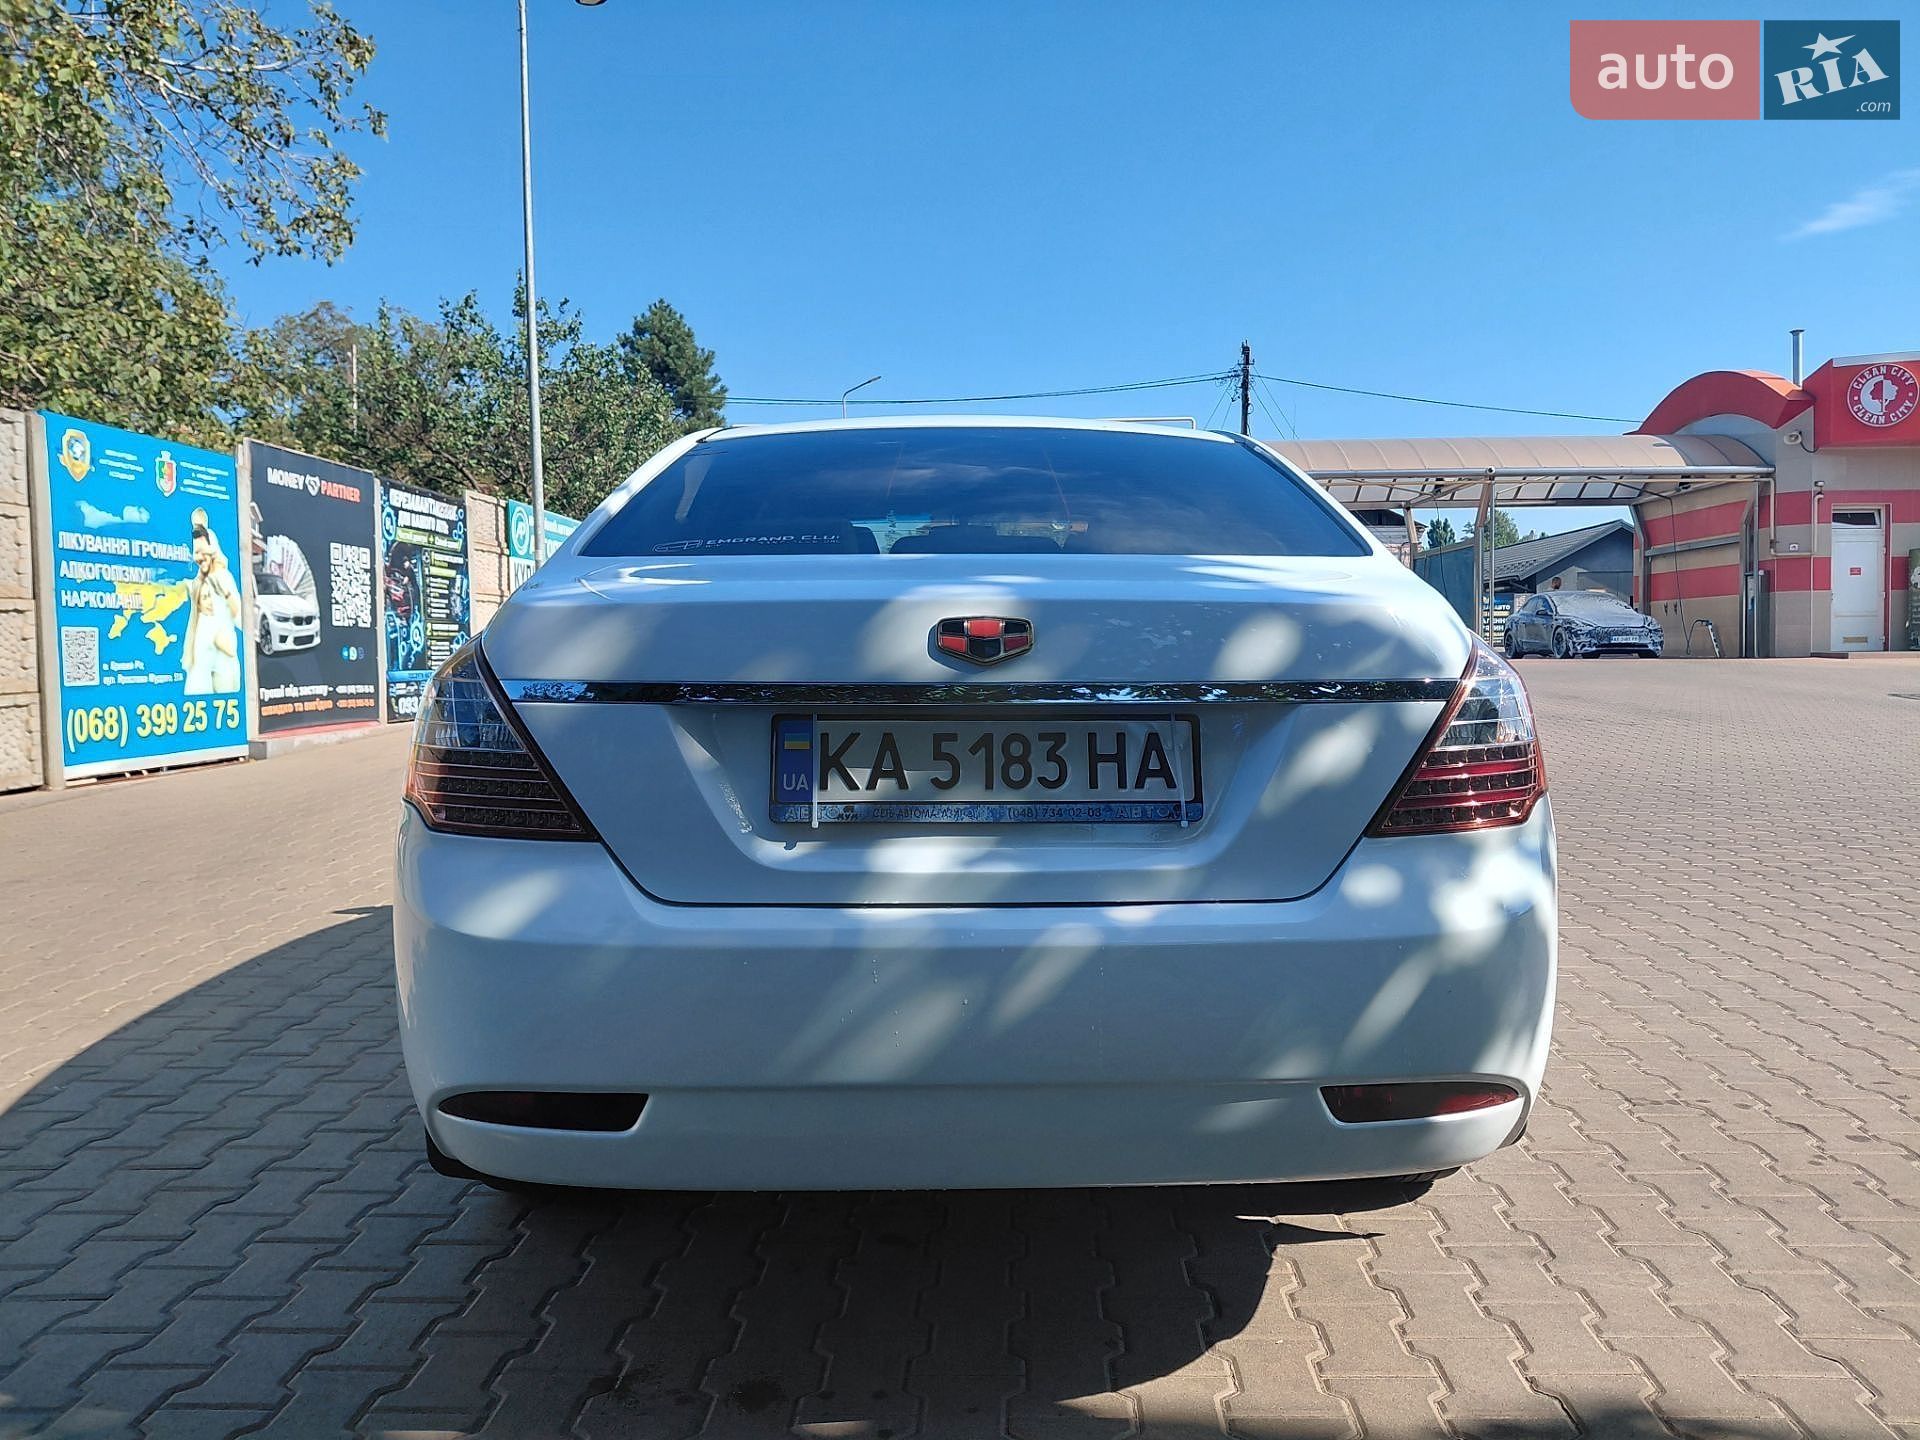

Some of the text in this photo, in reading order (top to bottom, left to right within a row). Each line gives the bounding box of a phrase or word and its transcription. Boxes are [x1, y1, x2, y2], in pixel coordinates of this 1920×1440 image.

[1852, 365, 1915, 390] CLEAN CITY
[1853, 400, 1914, 425] CLEAN CITY
[266, 467, 361, 503] MONEY PARTNER
[58, 531, 130, 556] ЛІКУВАННЯ
[706, 535, 794, 545] EMGRAND
[67, 698, 240, 753] (068) 399 25 75
[819, 731, 1176, 791] KA 5183 HA
[783, 773, 809, 791] UA
